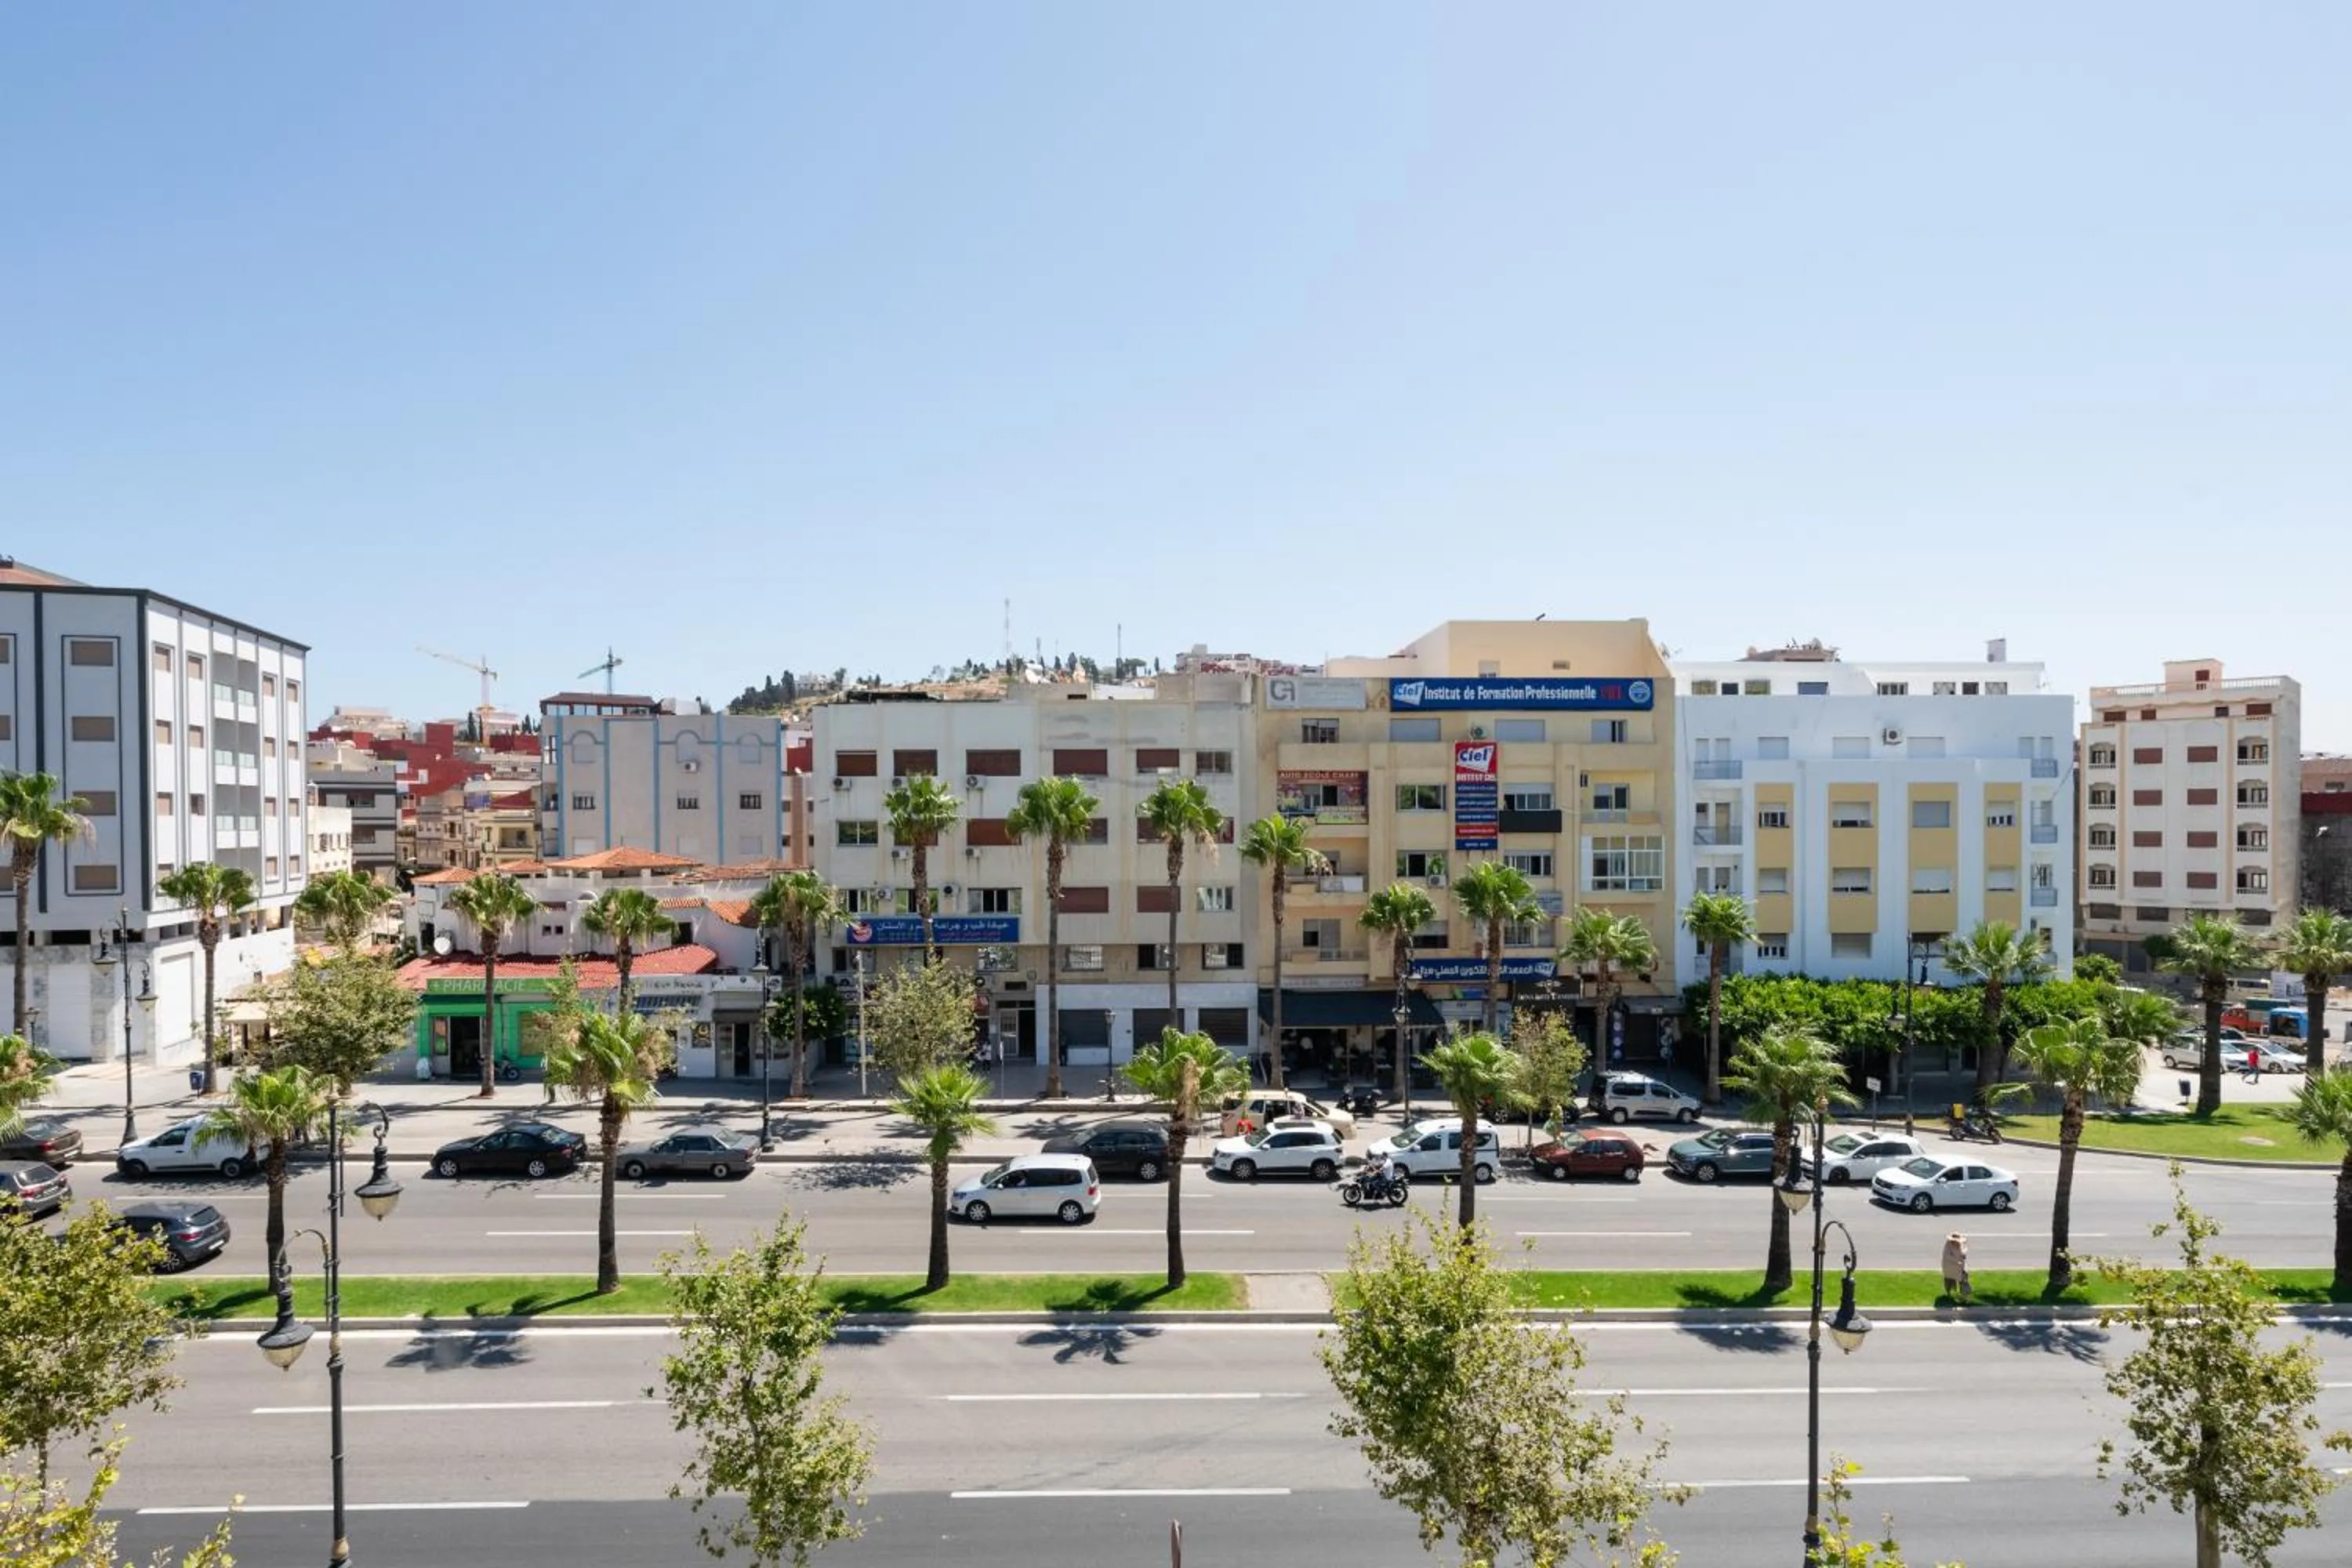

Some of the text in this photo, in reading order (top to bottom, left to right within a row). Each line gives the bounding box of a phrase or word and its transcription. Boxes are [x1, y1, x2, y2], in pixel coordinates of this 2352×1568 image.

[1425, 685, 1461, 700] Institut
[1464, 685, 1475, 700] de
[1478, 685, 1524, 700] Formation
[1525, 684, 1597, 700] Professionnelle
[1460, 748, 1488, 762] Ciel
[445, 979, 525, 992] PHARACIE
